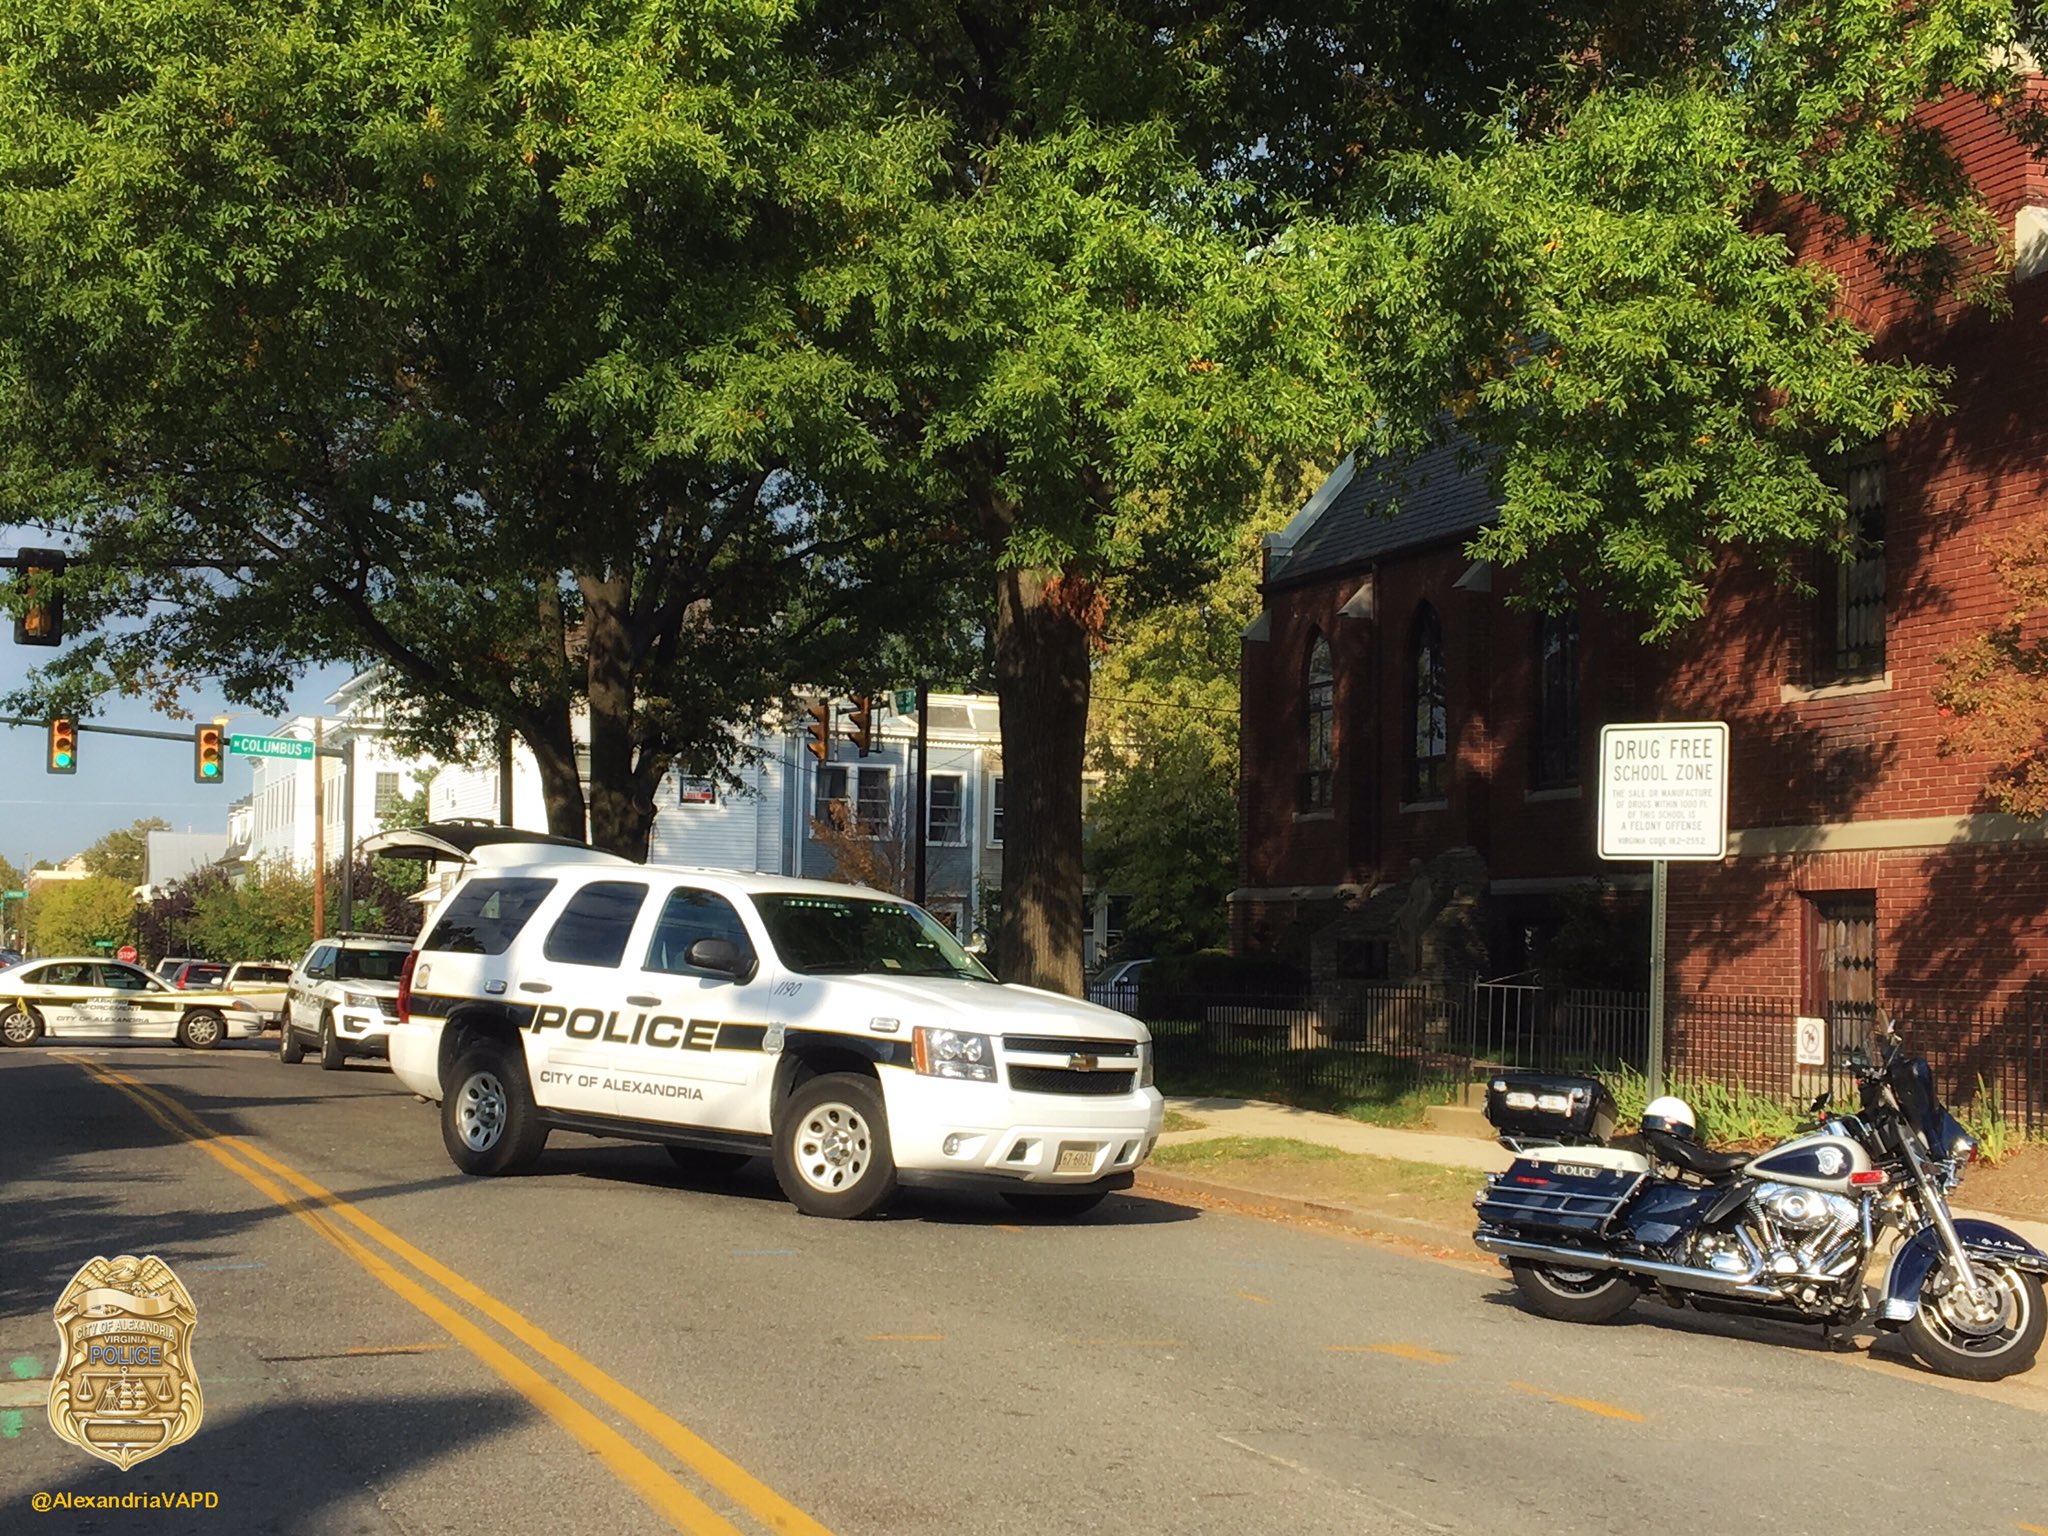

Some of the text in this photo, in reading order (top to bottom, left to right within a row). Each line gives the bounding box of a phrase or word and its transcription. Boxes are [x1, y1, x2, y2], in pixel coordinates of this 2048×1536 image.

[241, 738, 303, 756] COLUMBUS
[303, 746, 311, 754] ST
[1615, 738, 1713, 760] DRUG FREE
[1613, 764, 1713, 781] SCHOOL ZONE
[1612, 789, 1712, 798] THE SALE OR MANUFACTURE
[1616, 801, 1624, 809] OF
[1628, 801, 1651, 809] DRUGS
[1654, 801, 1678, 809] WITHIN
[1680, 801, 1697, 809] 1000
[1627, 811, 1696, 819] OF THIS SCHOOL IS
[1621, 821, 1702, 831] A FELONY OFFENSE
[118, 951, 136, 959] STOP
[773, 981, 803, 997] 1190
[72, 1004, 141, 1012] ENFORCEMENT
[531, 1004, 721, 1052] POLICE
[540, 1070, 704, 1101] CITY OF ALEXANDRIA
[1557, 1164, 1596, 1178] POLICE
